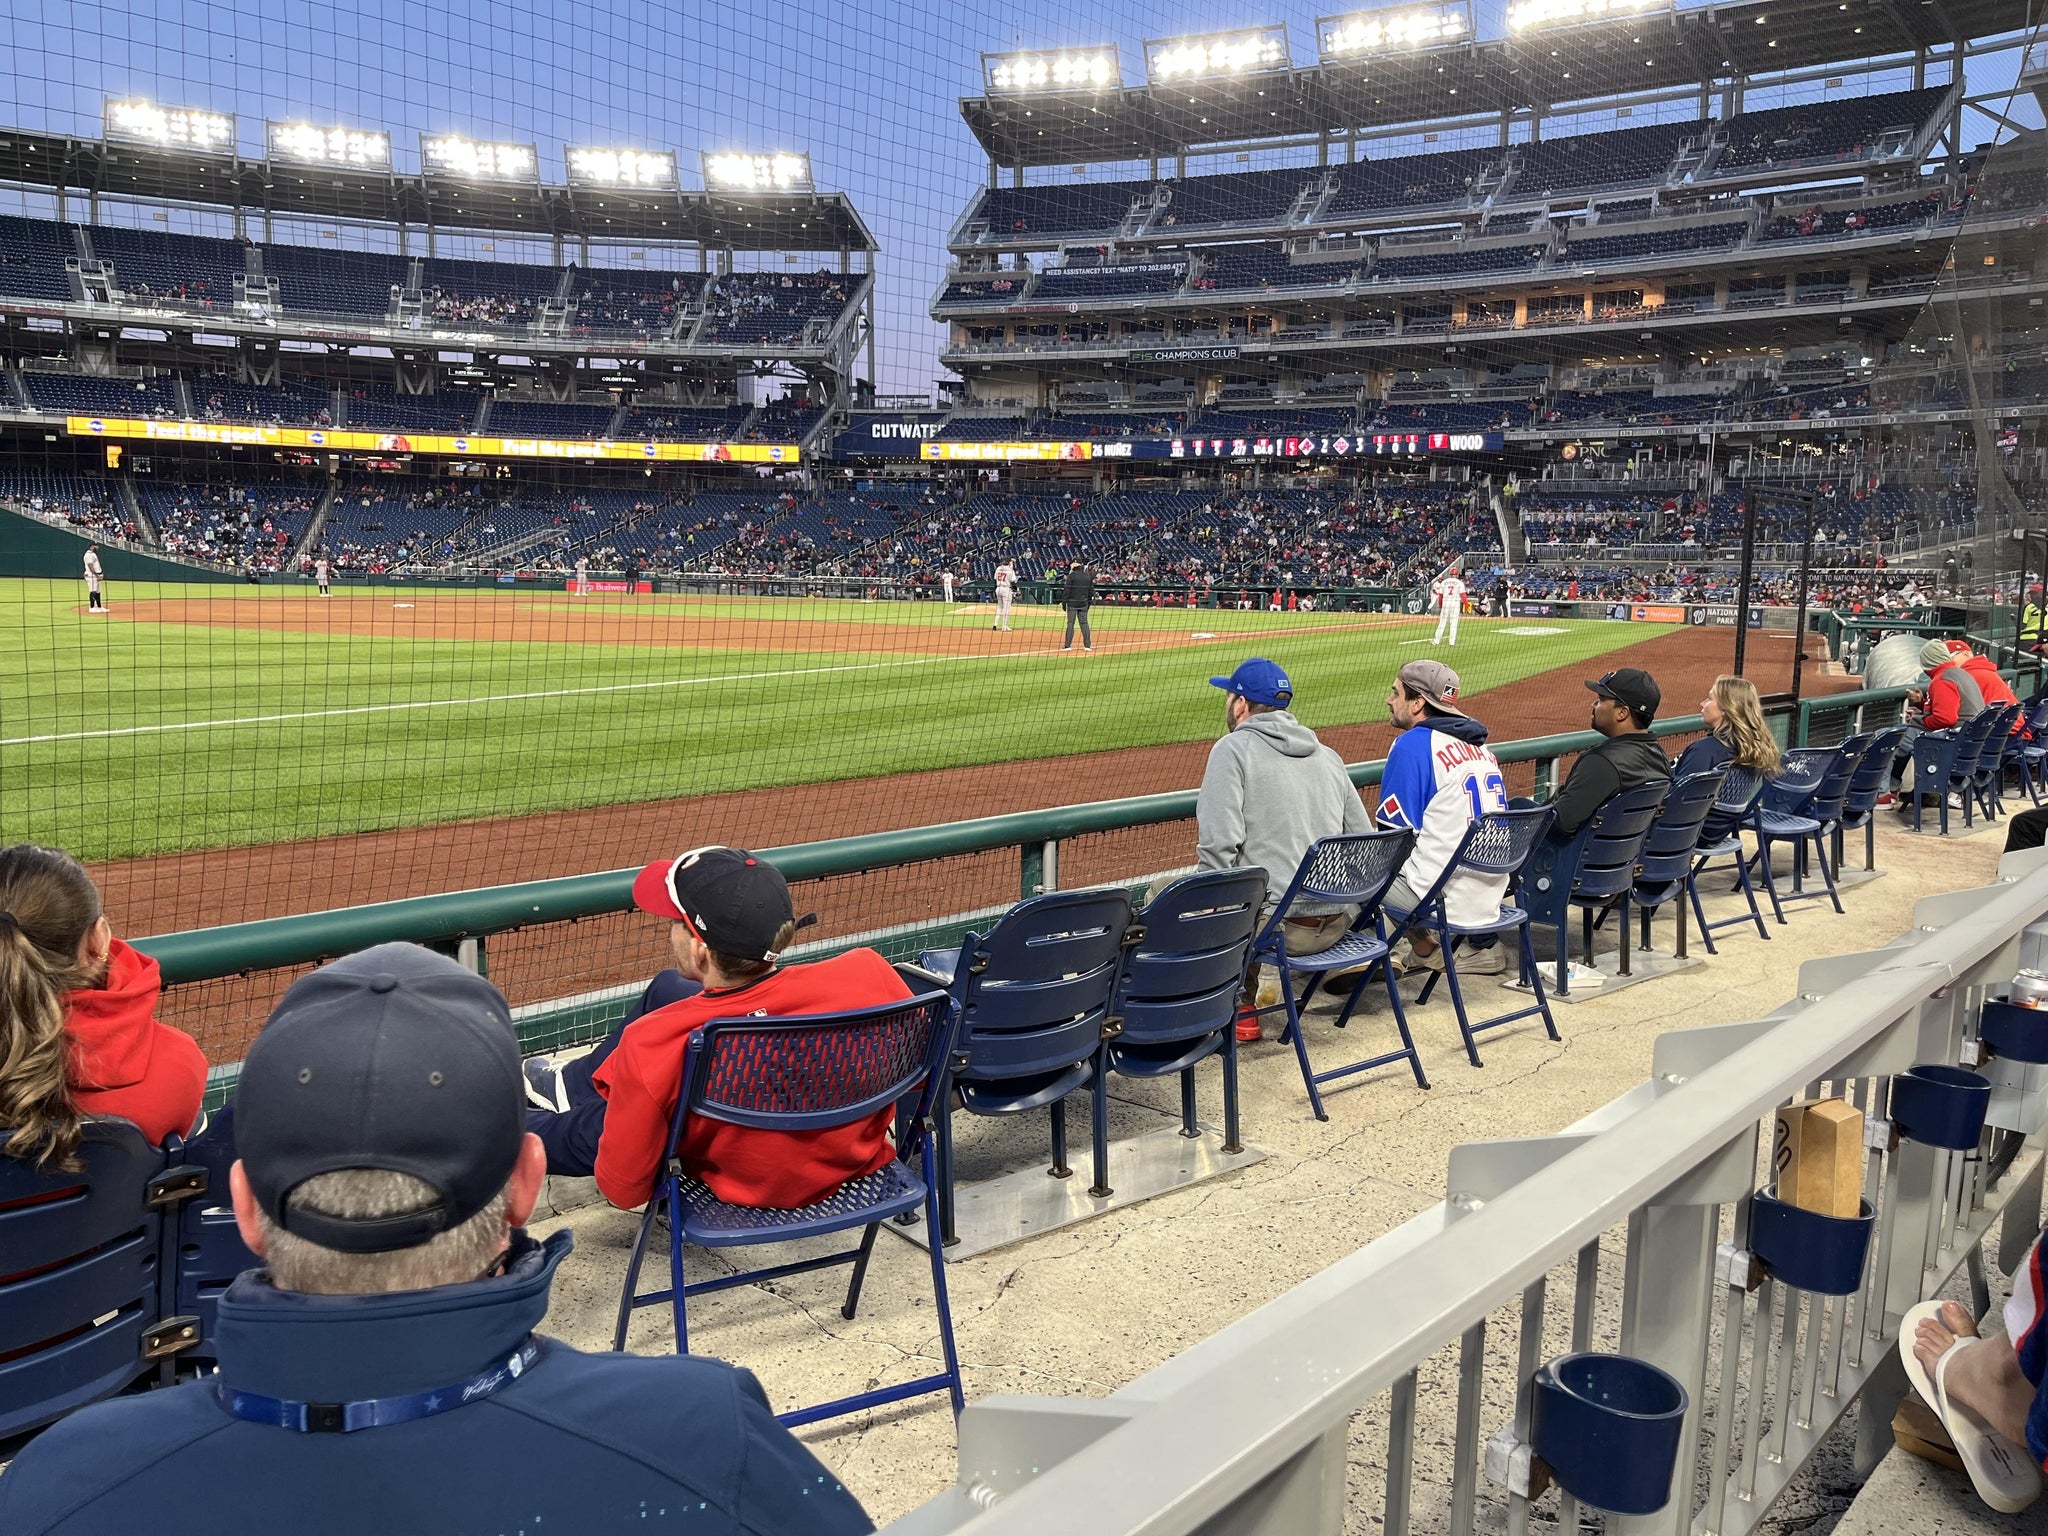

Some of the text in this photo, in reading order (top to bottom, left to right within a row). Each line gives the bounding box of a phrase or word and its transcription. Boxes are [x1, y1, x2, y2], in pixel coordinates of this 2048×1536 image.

[1155, 350, 1210, 360] CHAMPIONS
[1211, 349, 1237, 358] CLUB
[872, 423, 946, 438] CUTWATE
[1320, 438, 1328, 453] 2
[1356, 437, 1364, 452] 3
[1391, 442, 1399, 453] 0
[1408, 442, 1416, 453] 0
[1449, 434, 1484, 451] WOOD
[1092, 444, 1103, 457] 26
[1579, 446, 1611, 458] PNC
[997, 572, 1007, 582] 27
[1448, 586, 1454, 595] 7
[1707, 608, 1738, 616] NATIONA
[1462, 772, 1510, 829] 13
